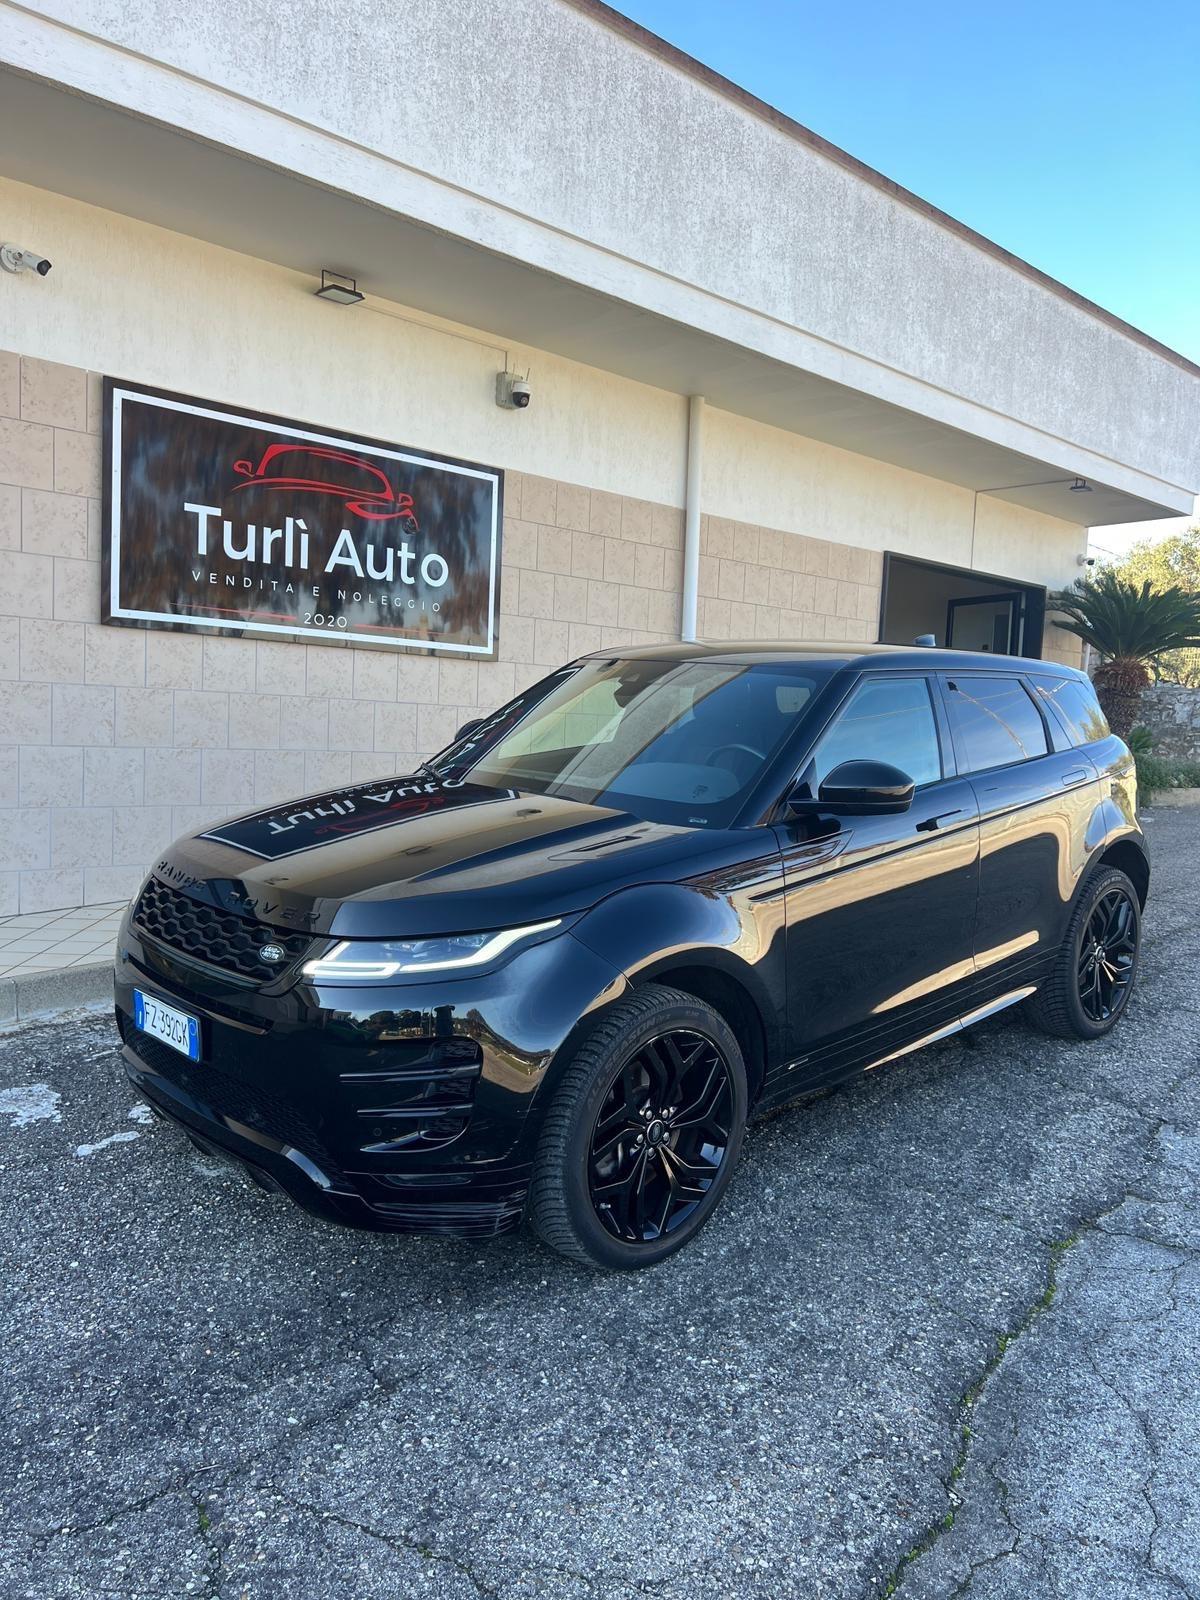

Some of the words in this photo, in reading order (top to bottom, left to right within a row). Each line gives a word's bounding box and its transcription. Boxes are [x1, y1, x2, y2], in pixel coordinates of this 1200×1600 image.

[184, 502, 309, 570] Turlì
[324, 529, 449, 588] Auto
[192, 570, 294, 594] VENDITA
[313, 586, 320, 597] E
[338, 589, 440, 612] NOLEGGIO
[304, 612, 347, 628] 2020
